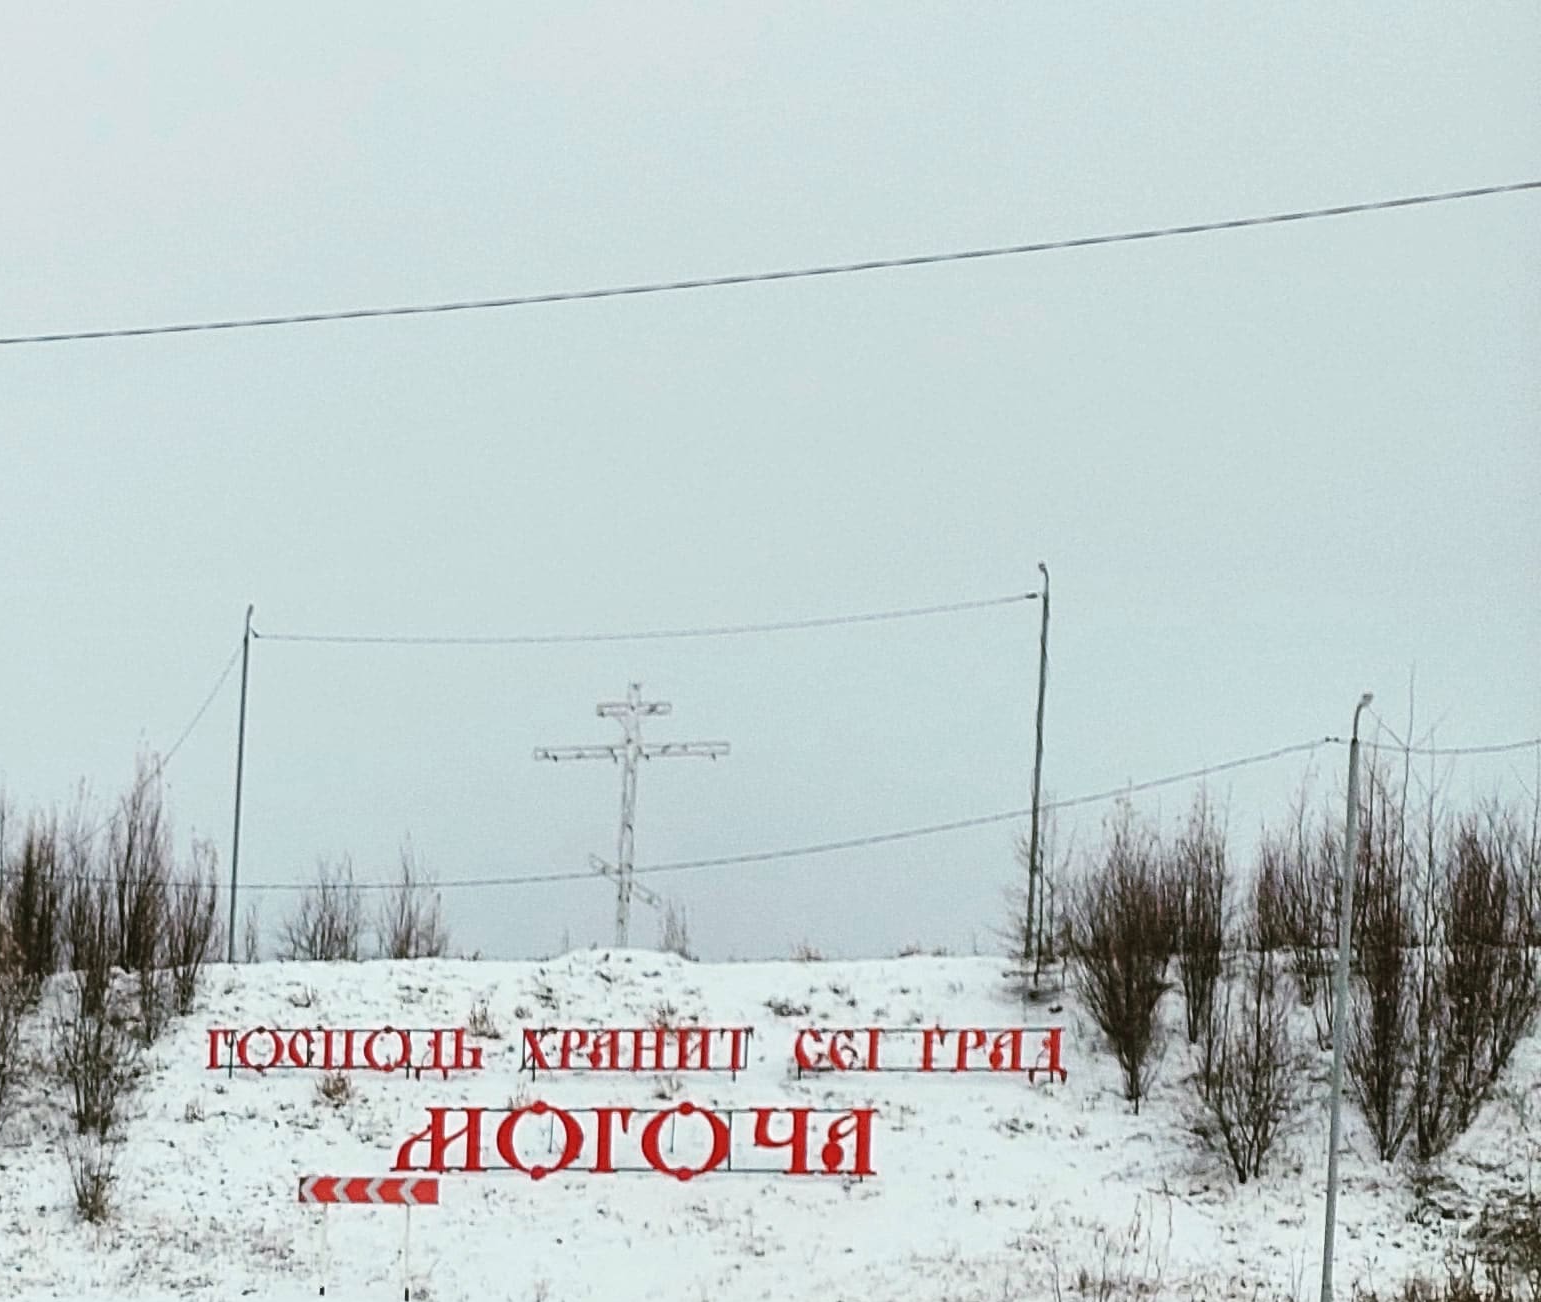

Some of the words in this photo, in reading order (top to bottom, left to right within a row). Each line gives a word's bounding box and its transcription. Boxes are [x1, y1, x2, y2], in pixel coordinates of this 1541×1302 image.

[206, 1026, 484, 1080] ГОСПОДЬ
[521, 1026, 754, 1071] ХРАНИТ
[919, 1025, 1068, 1085] ГРАД
[390, 1100, 878, 1181] МОГОЧА
